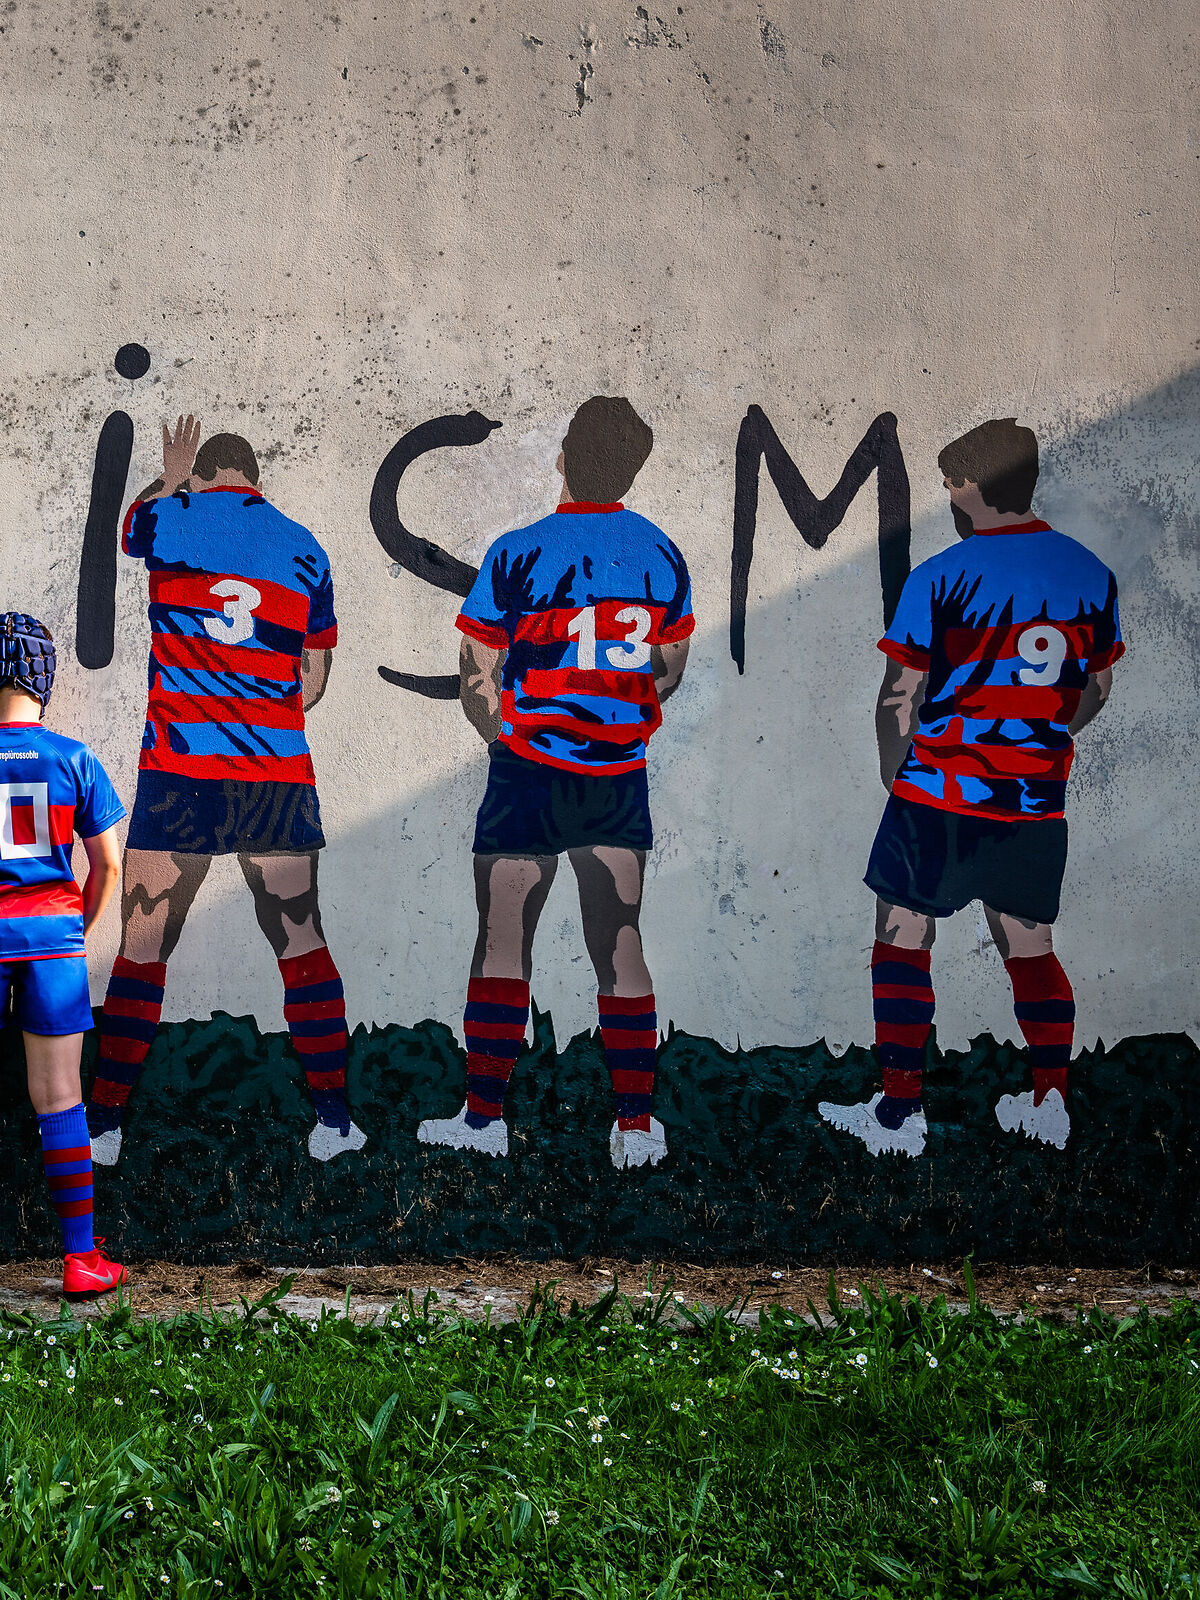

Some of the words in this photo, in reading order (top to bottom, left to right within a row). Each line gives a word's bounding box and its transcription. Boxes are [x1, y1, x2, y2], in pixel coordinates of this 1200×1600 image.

[203, 579, 261, 644] 3
[567, 606, 652, 671] 13
[1017, 626, 1068, 686] 9
